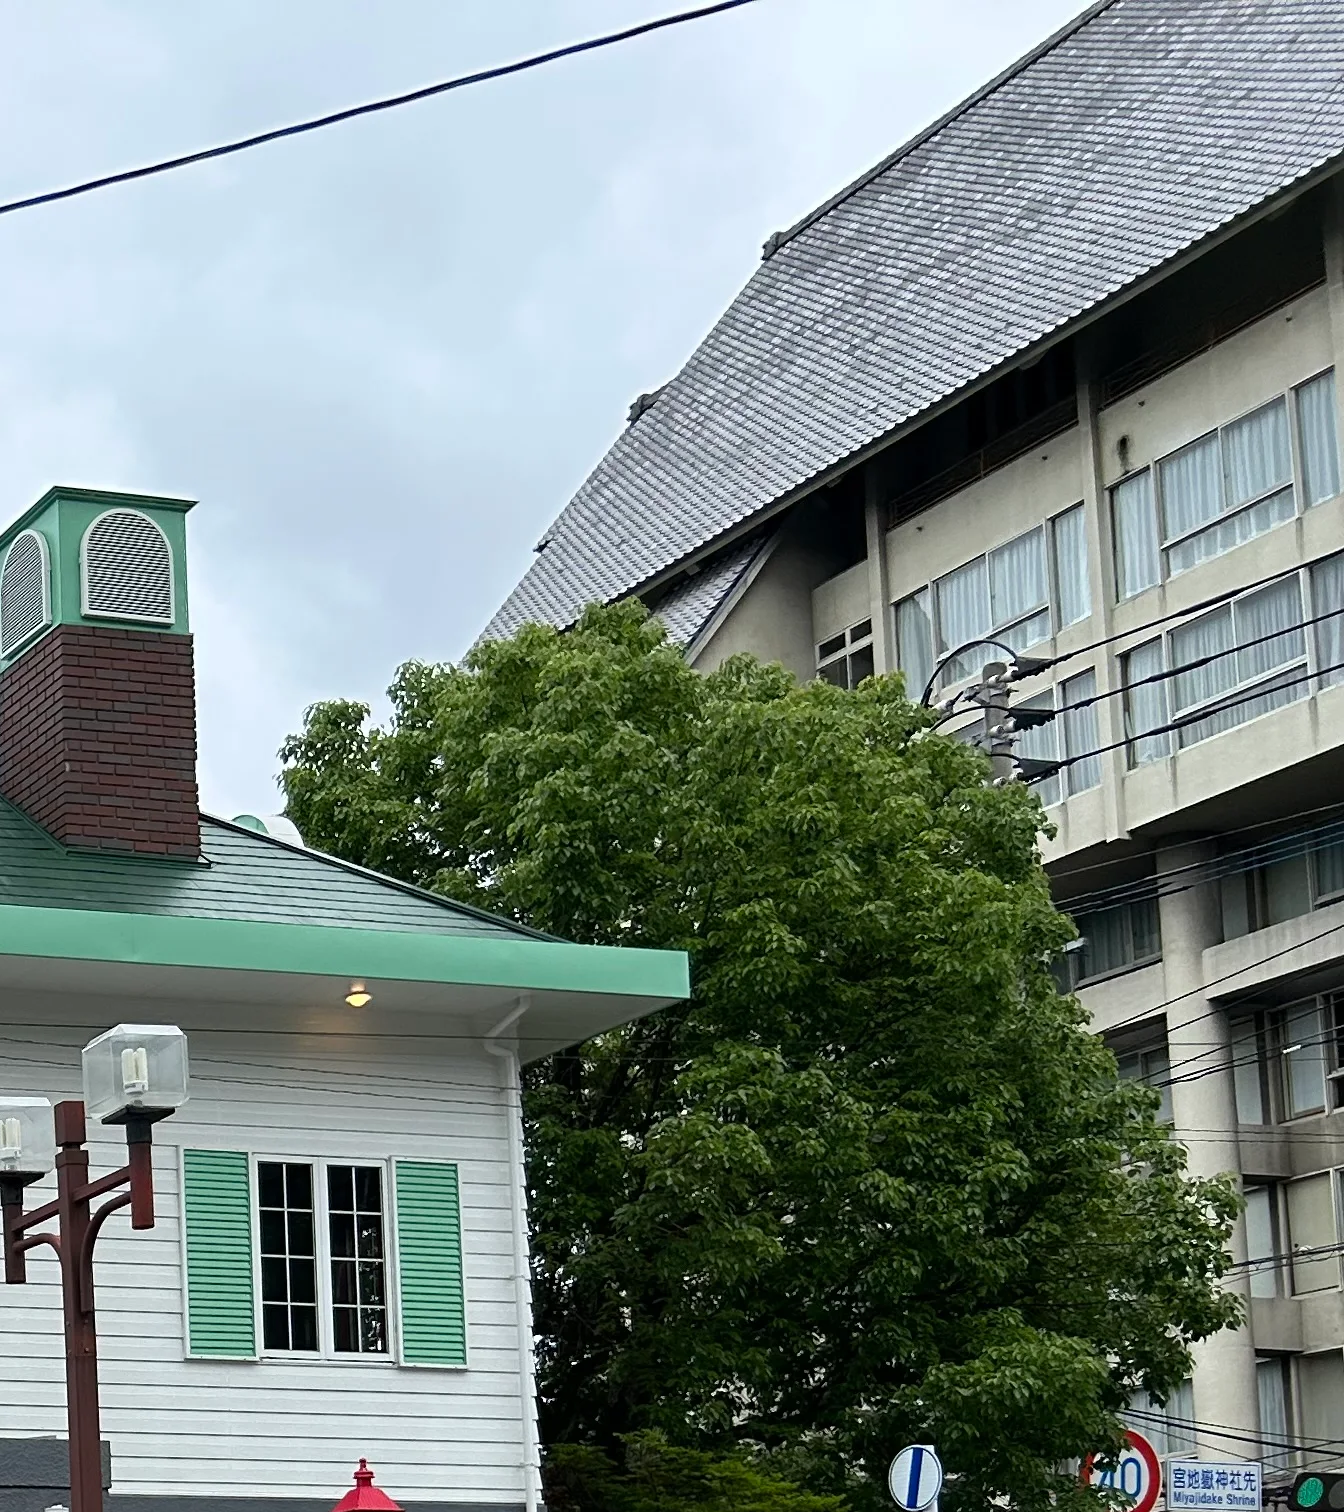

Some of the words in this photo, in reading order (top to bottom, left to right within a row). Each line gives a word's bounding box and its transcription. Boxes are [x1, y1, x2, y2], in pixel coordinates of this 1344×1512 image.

[1172, 1467, 1257, 1492] 宮地嶽神社先
[1173, 1491, 1223, 1506] Miyajidake
[1226, 1493, 1256, 1506] Shrine
